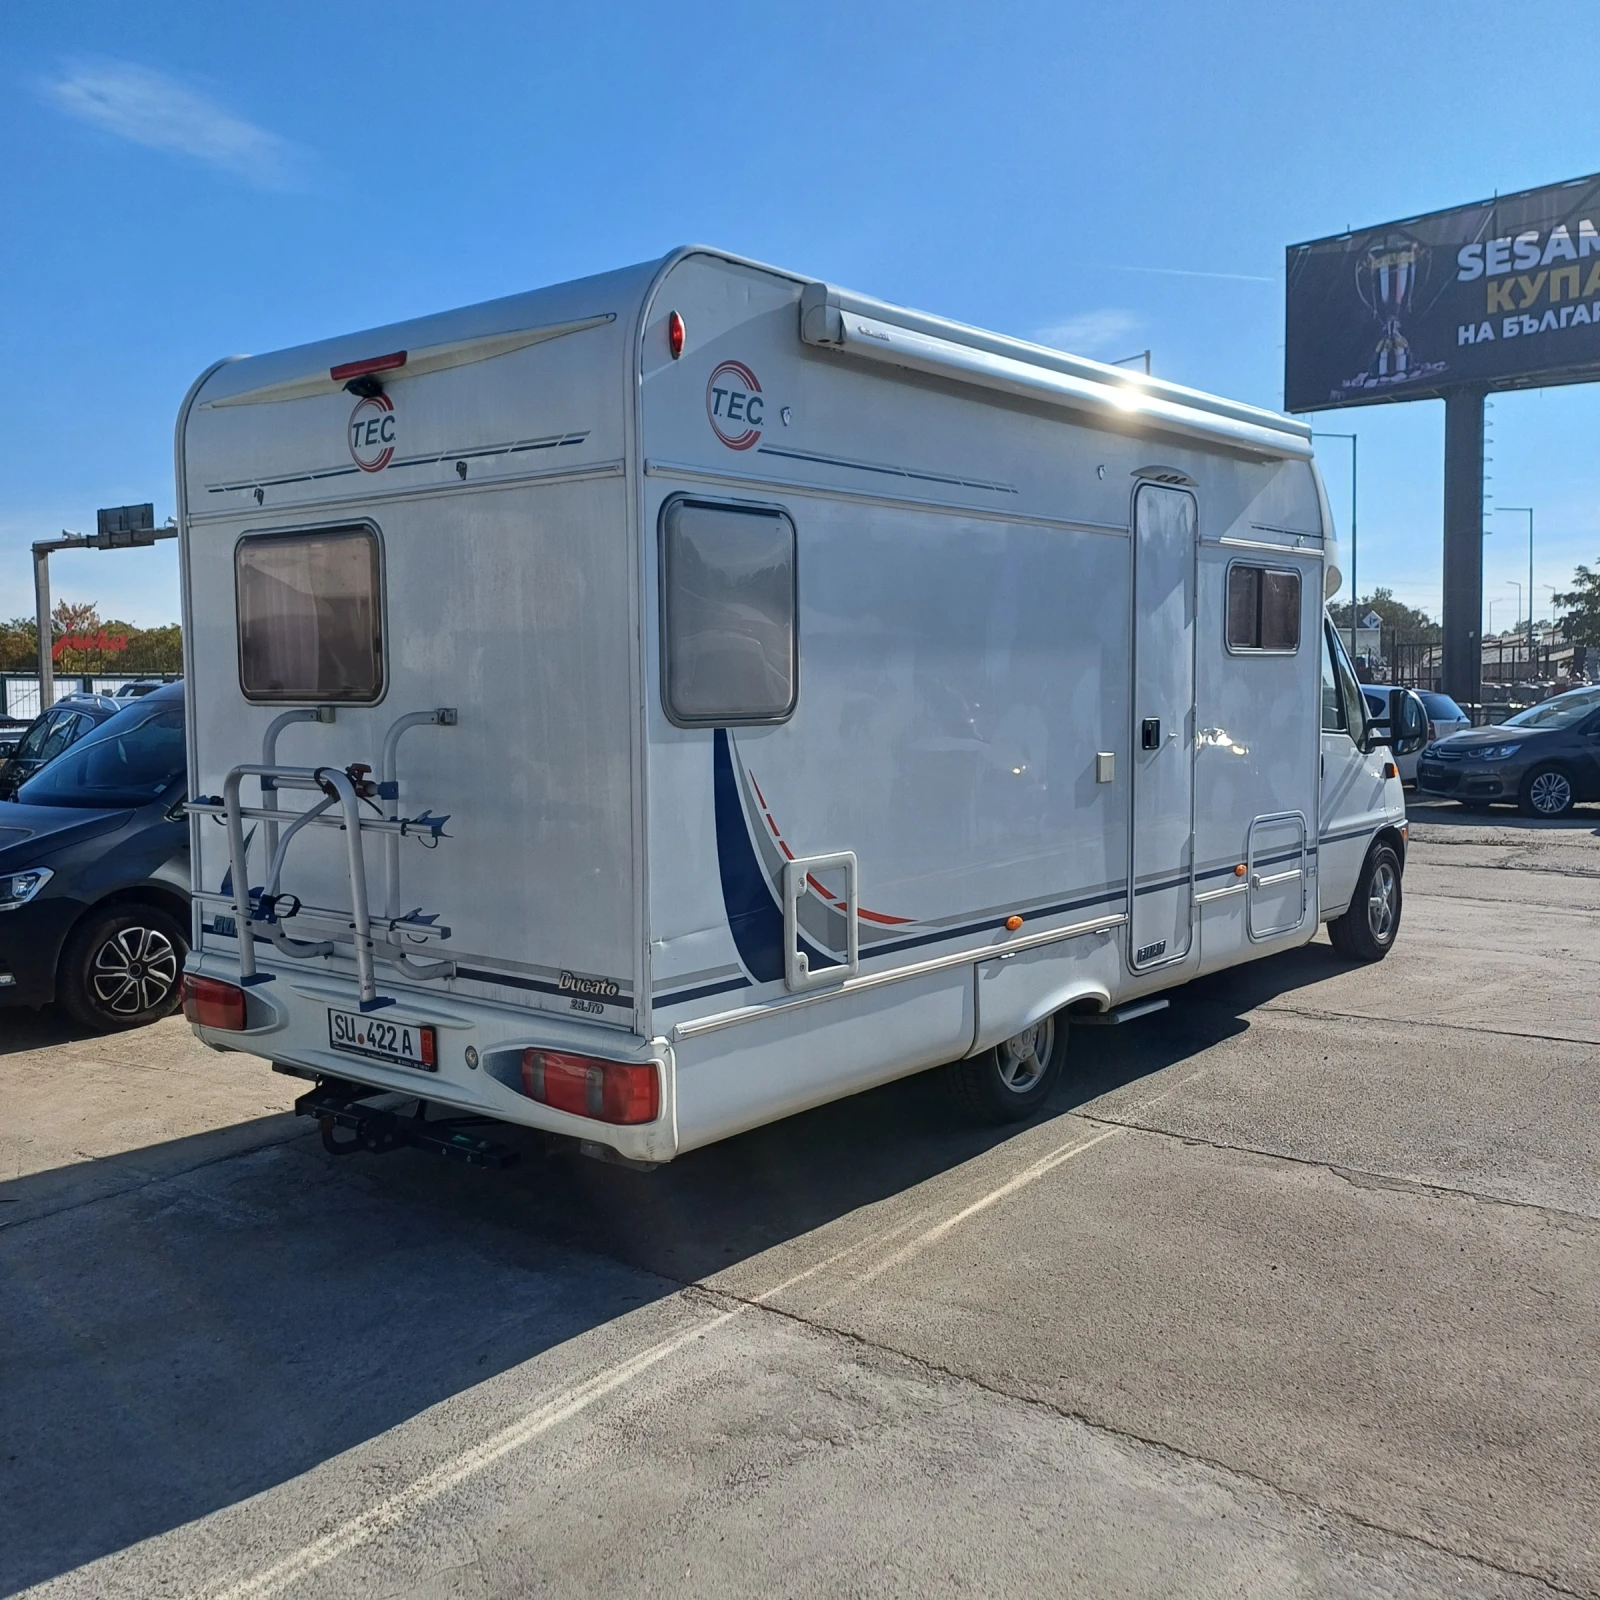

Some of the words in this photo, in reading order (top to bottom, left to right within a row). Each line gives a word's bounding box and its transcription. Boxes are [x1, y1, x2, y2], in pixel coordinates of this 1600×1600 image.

[1458, 321, 1495, 346] НА
[559, 971, 619, 996] Ducato
[335, 1015, 356, 1042] SU
